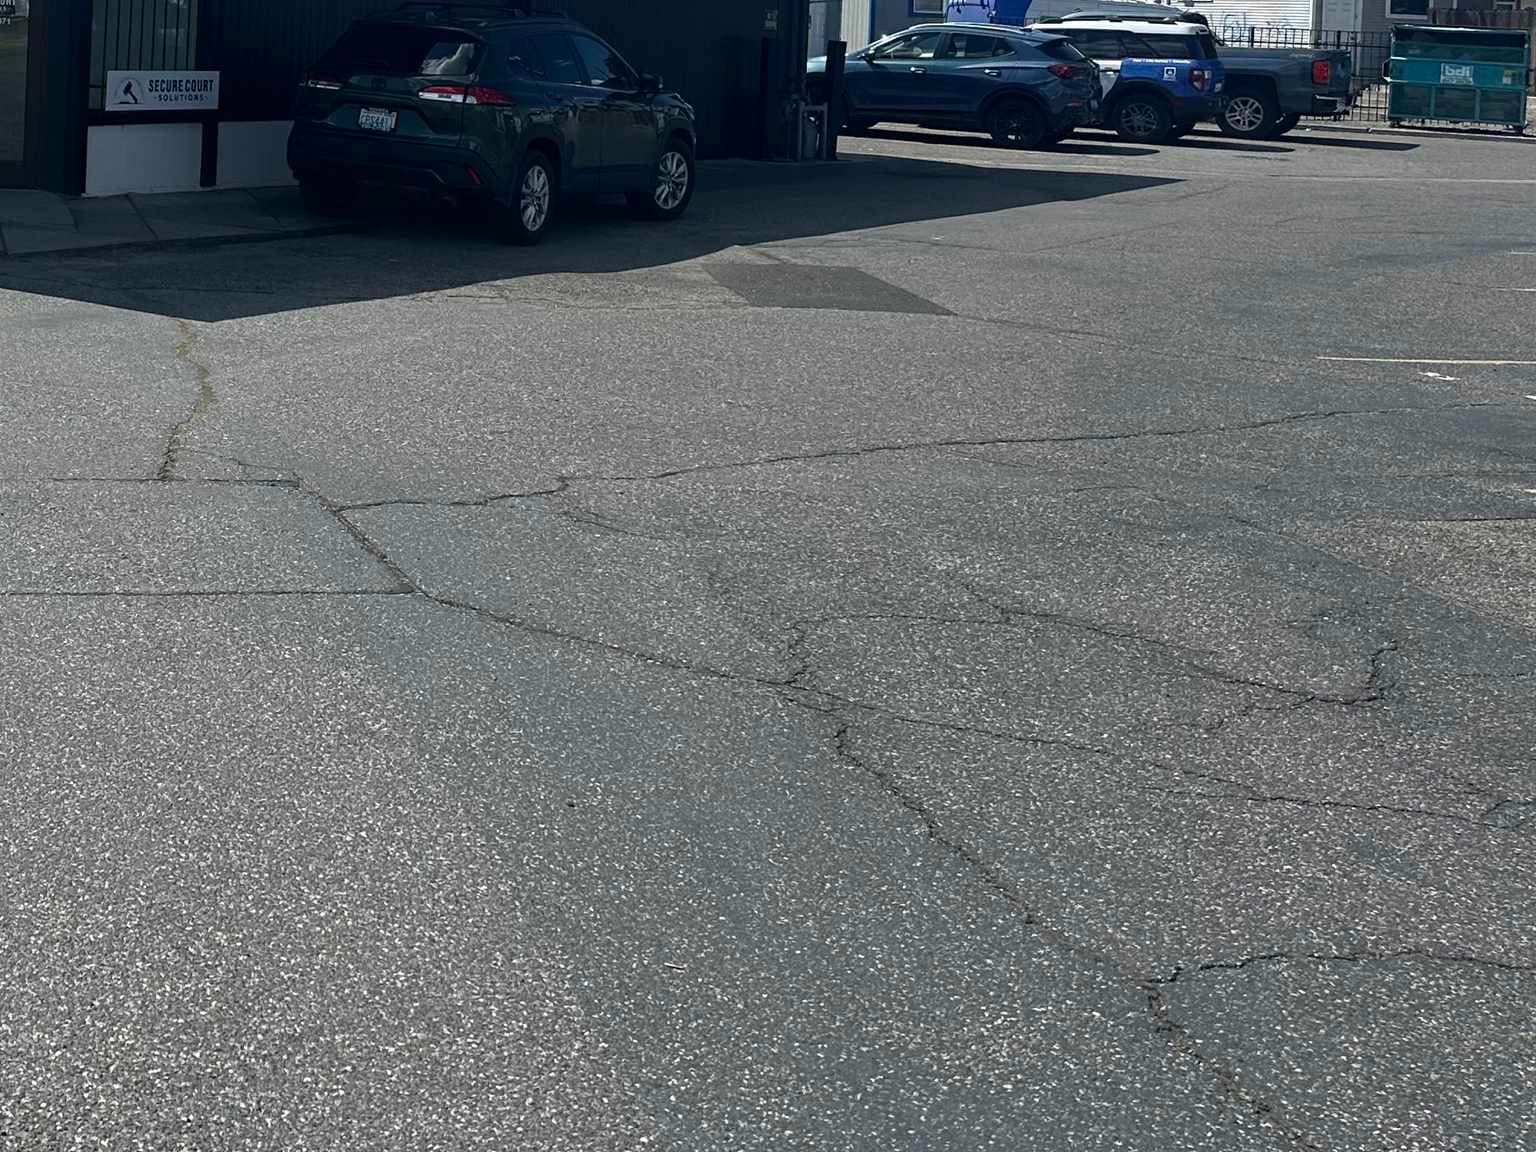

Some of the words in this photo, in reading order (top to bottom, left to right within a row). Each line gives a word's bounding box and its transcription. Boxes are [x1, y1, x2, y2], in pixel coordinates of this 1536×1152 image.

[148, 79, 183, 92] SECURE
[185, 79, 214, 93] COURT
[158, 94, 204, 102] SOLUTIONS
